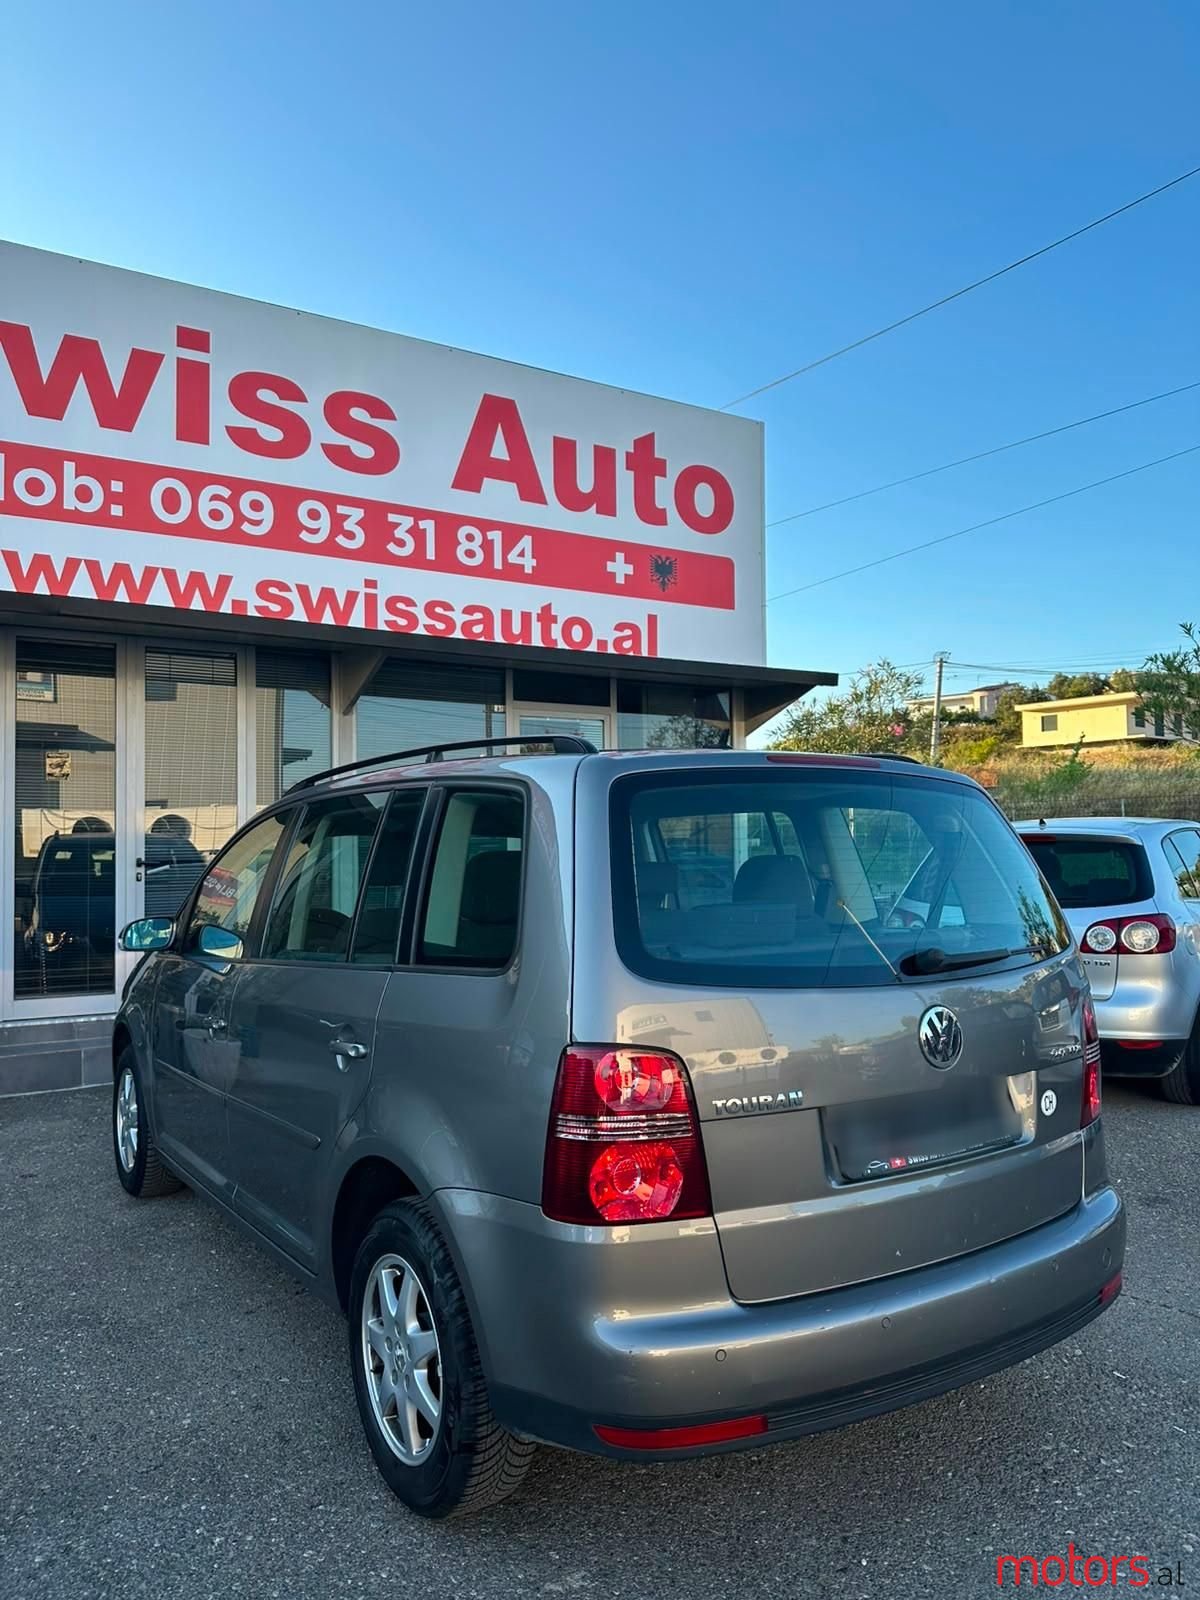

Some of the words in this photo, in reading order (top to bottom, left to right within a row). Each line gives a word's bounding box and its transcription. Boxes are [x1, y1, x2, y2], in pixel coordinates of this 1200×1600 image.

[0, 452, 124, 517] ob:
[150, 477, 275, 536] 069
[297, 499, 366, 550] 93
[386, 512, 436, 561] 31
[455, 525, 537, 574] 814
[451, 393, 735, 534] Auto
[1, 549, 658, 657] www.swissauto.al
[711, 1090, 803, 1115] TOURAN
